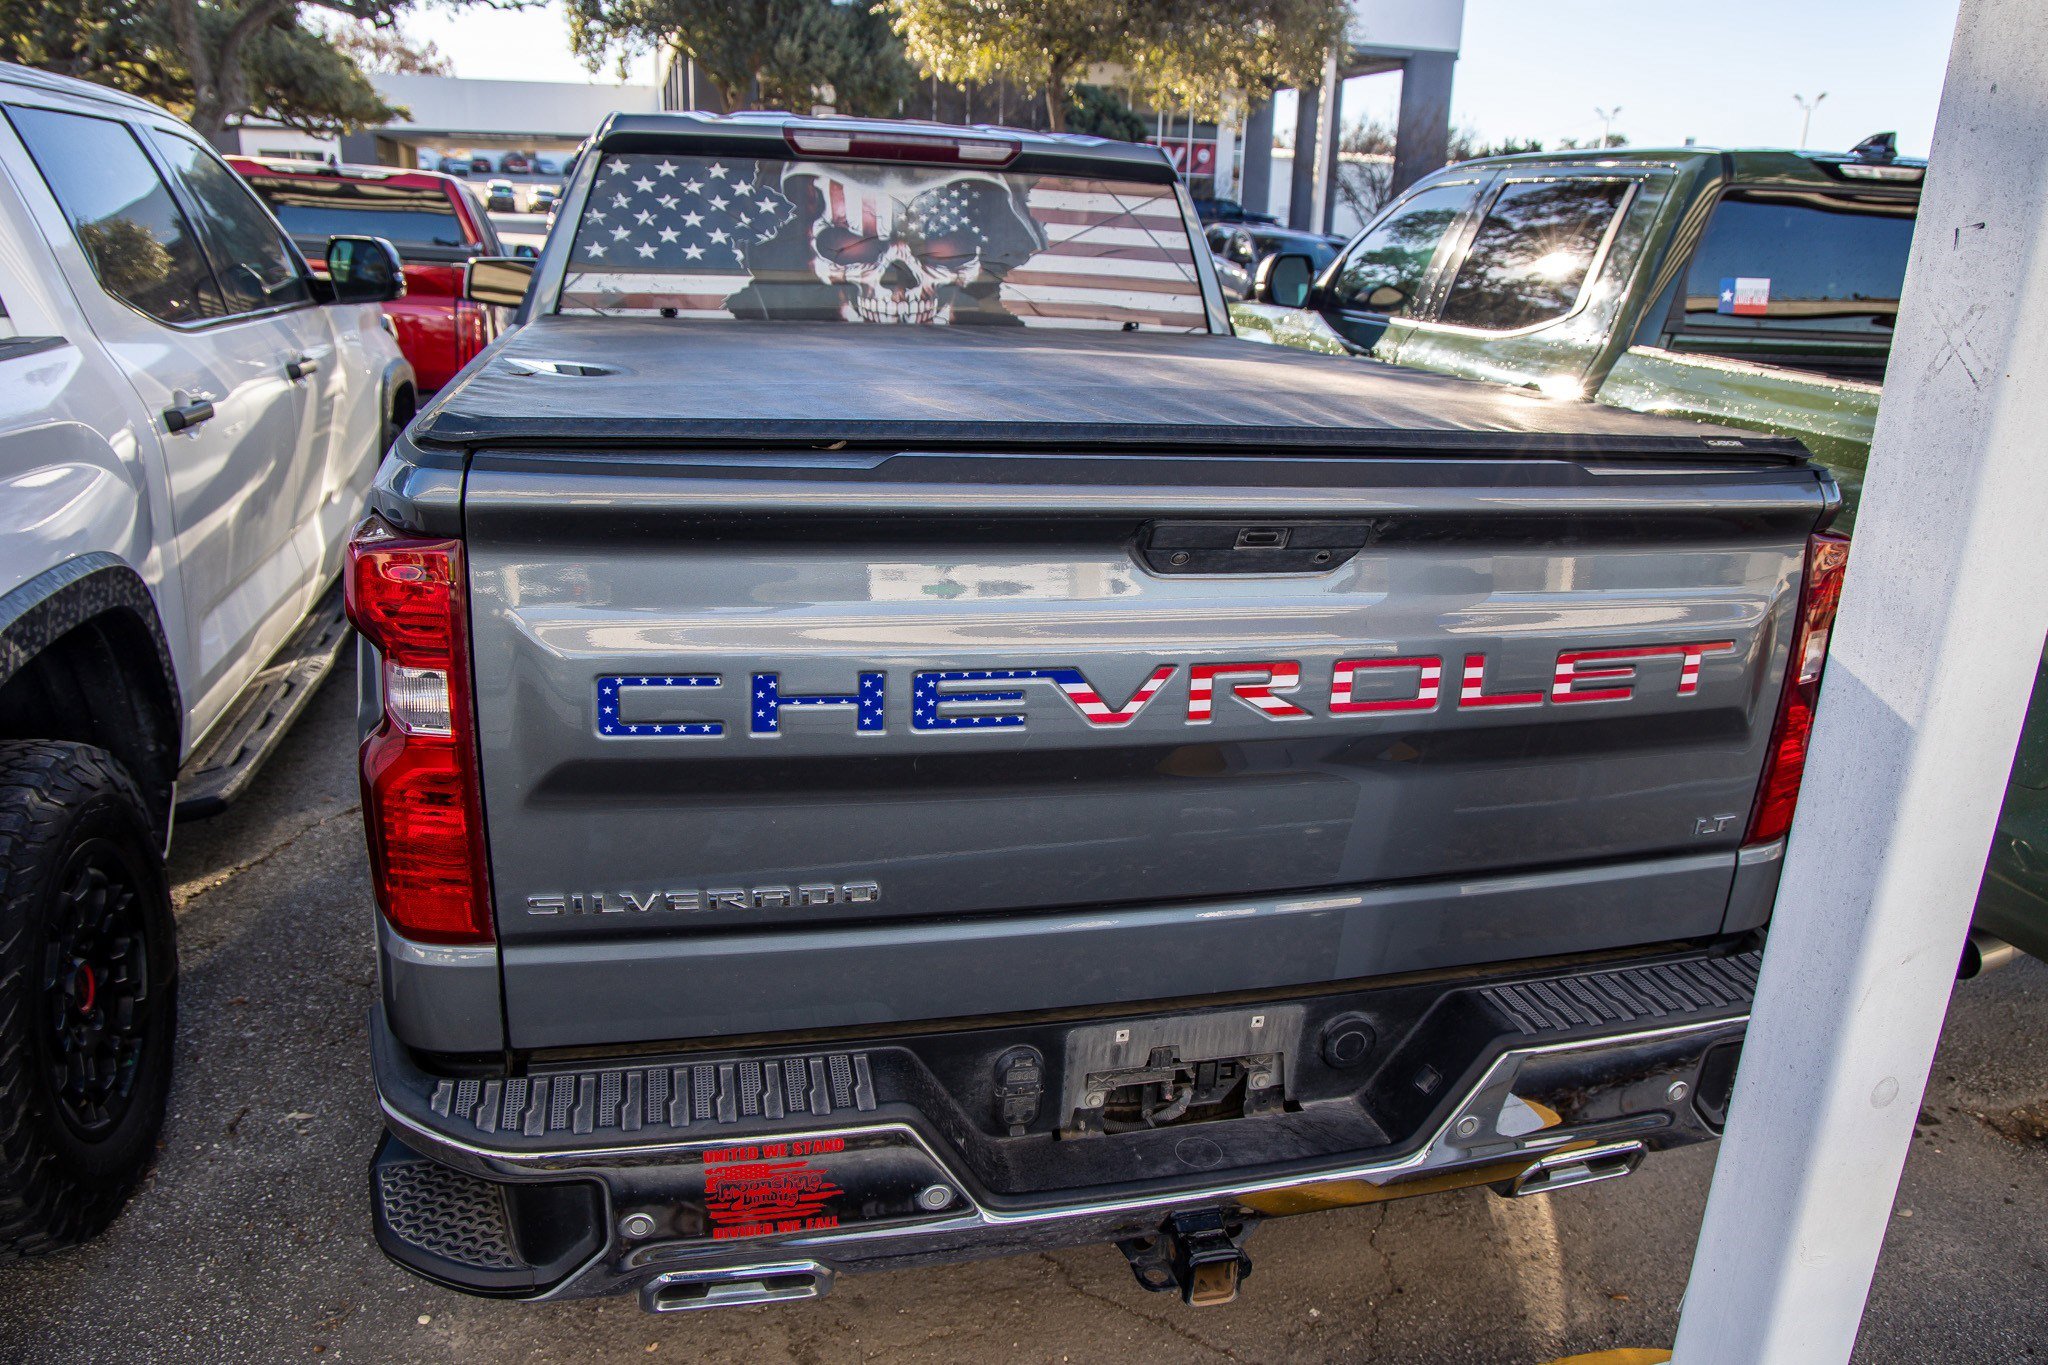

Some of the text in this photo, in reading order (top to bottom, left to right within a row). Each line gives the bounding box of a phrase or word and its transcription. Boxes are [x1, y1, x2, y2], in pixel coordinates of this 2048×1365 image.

[596, 640, 1735, 739] CHEVROLET
[1693, 813, 1737, 836] LT
[526, 880, 880, 915] SILVERADO
[703, 1138, 845, 1163] UNITED WE STAND
[713, 1216, 839, 1239] DIVIDED WE FALL
